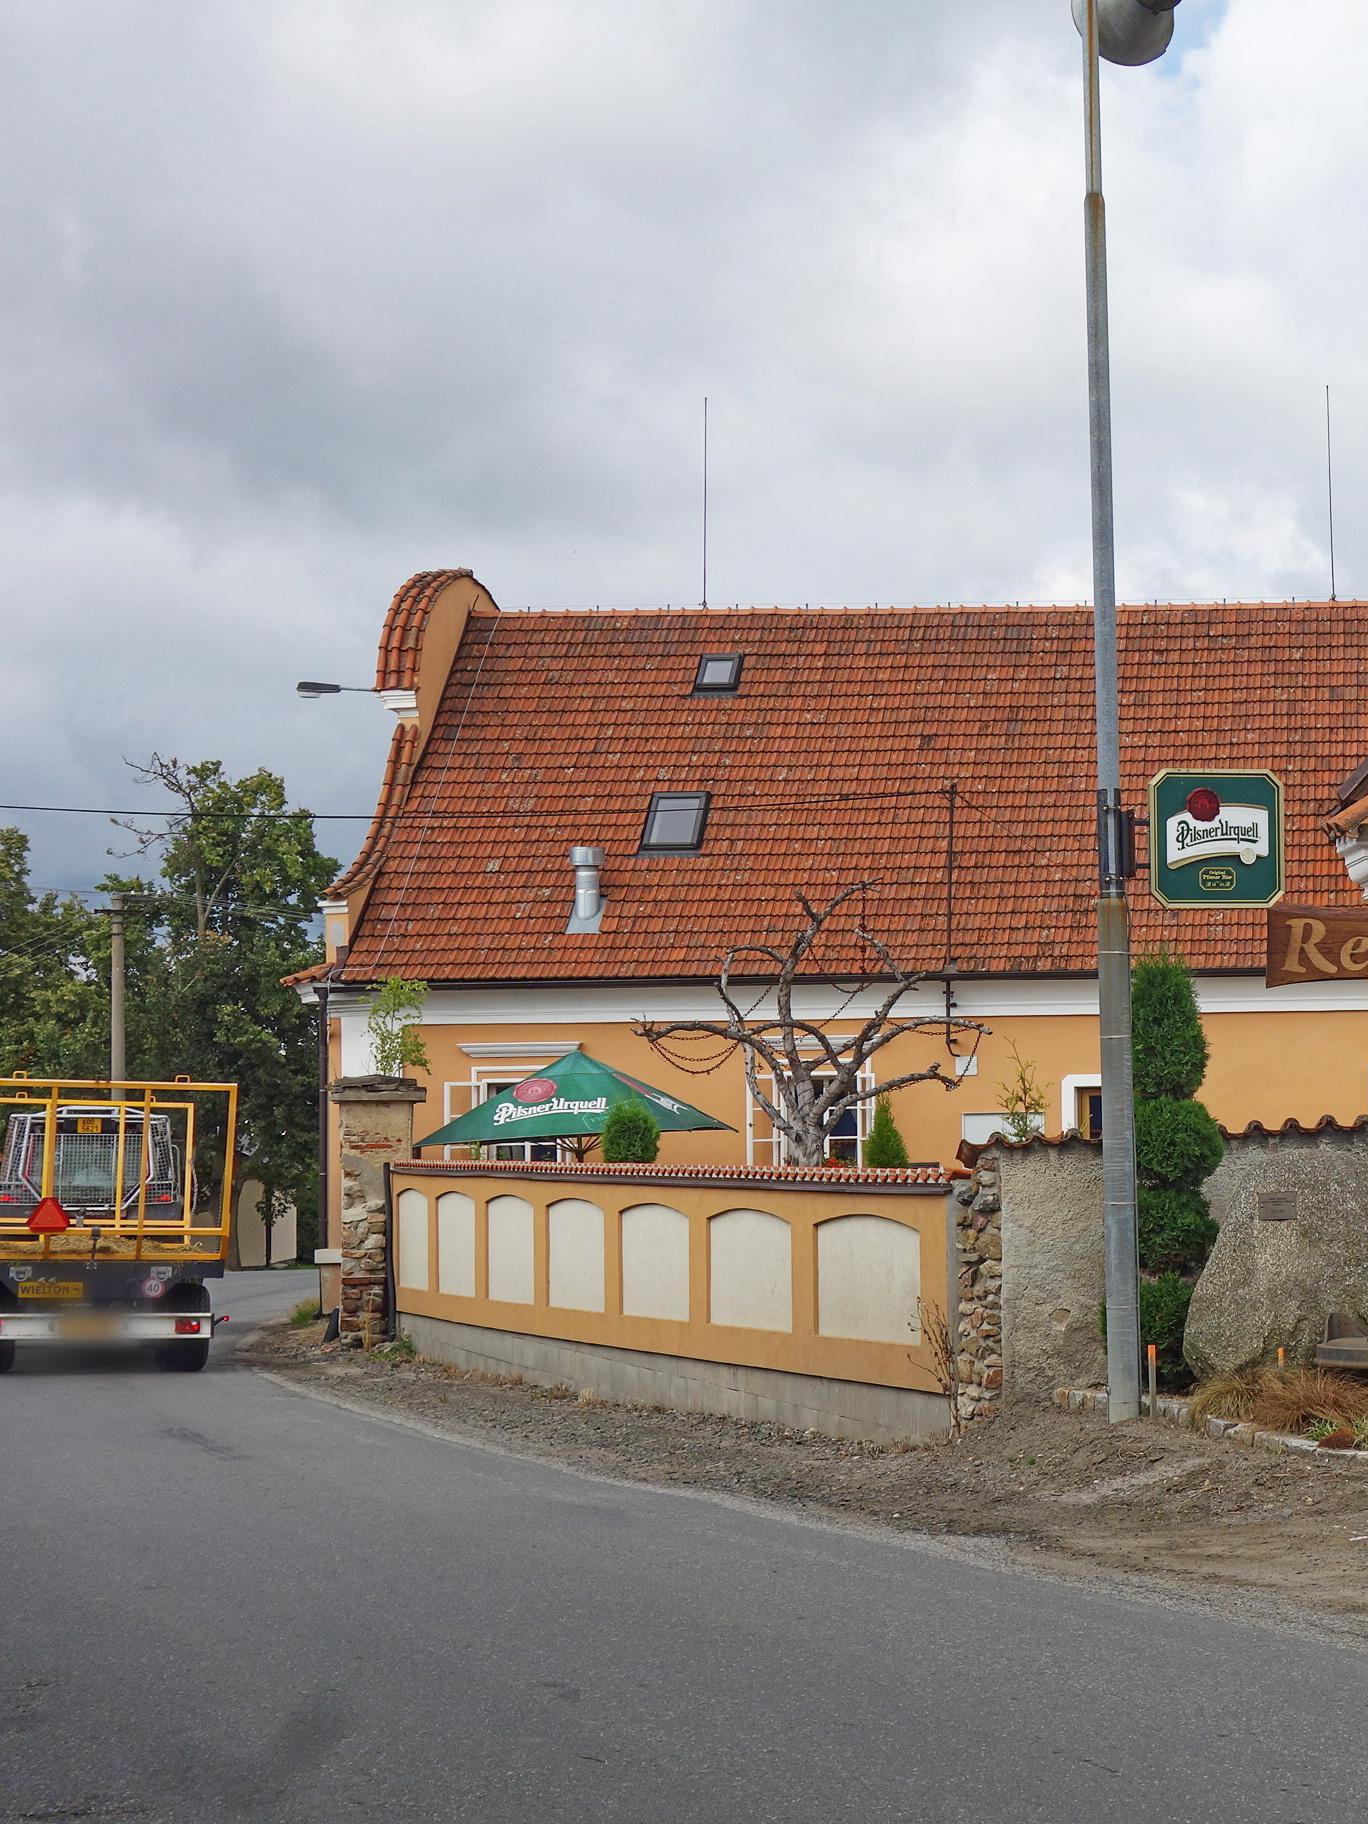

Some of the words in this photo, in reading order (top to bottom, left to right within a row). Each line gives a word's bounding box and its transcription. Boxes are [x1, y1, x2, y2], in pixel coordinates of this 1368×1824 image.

[1176, 820, 1220, 850] Pilsner
[1219, 819, 1259, 844] Urquell
[493, 1102, 553, 1126] Pilsner
[551, 1097, 607, 1115] Urquell
[147, 1283, 160, 1292] 40
